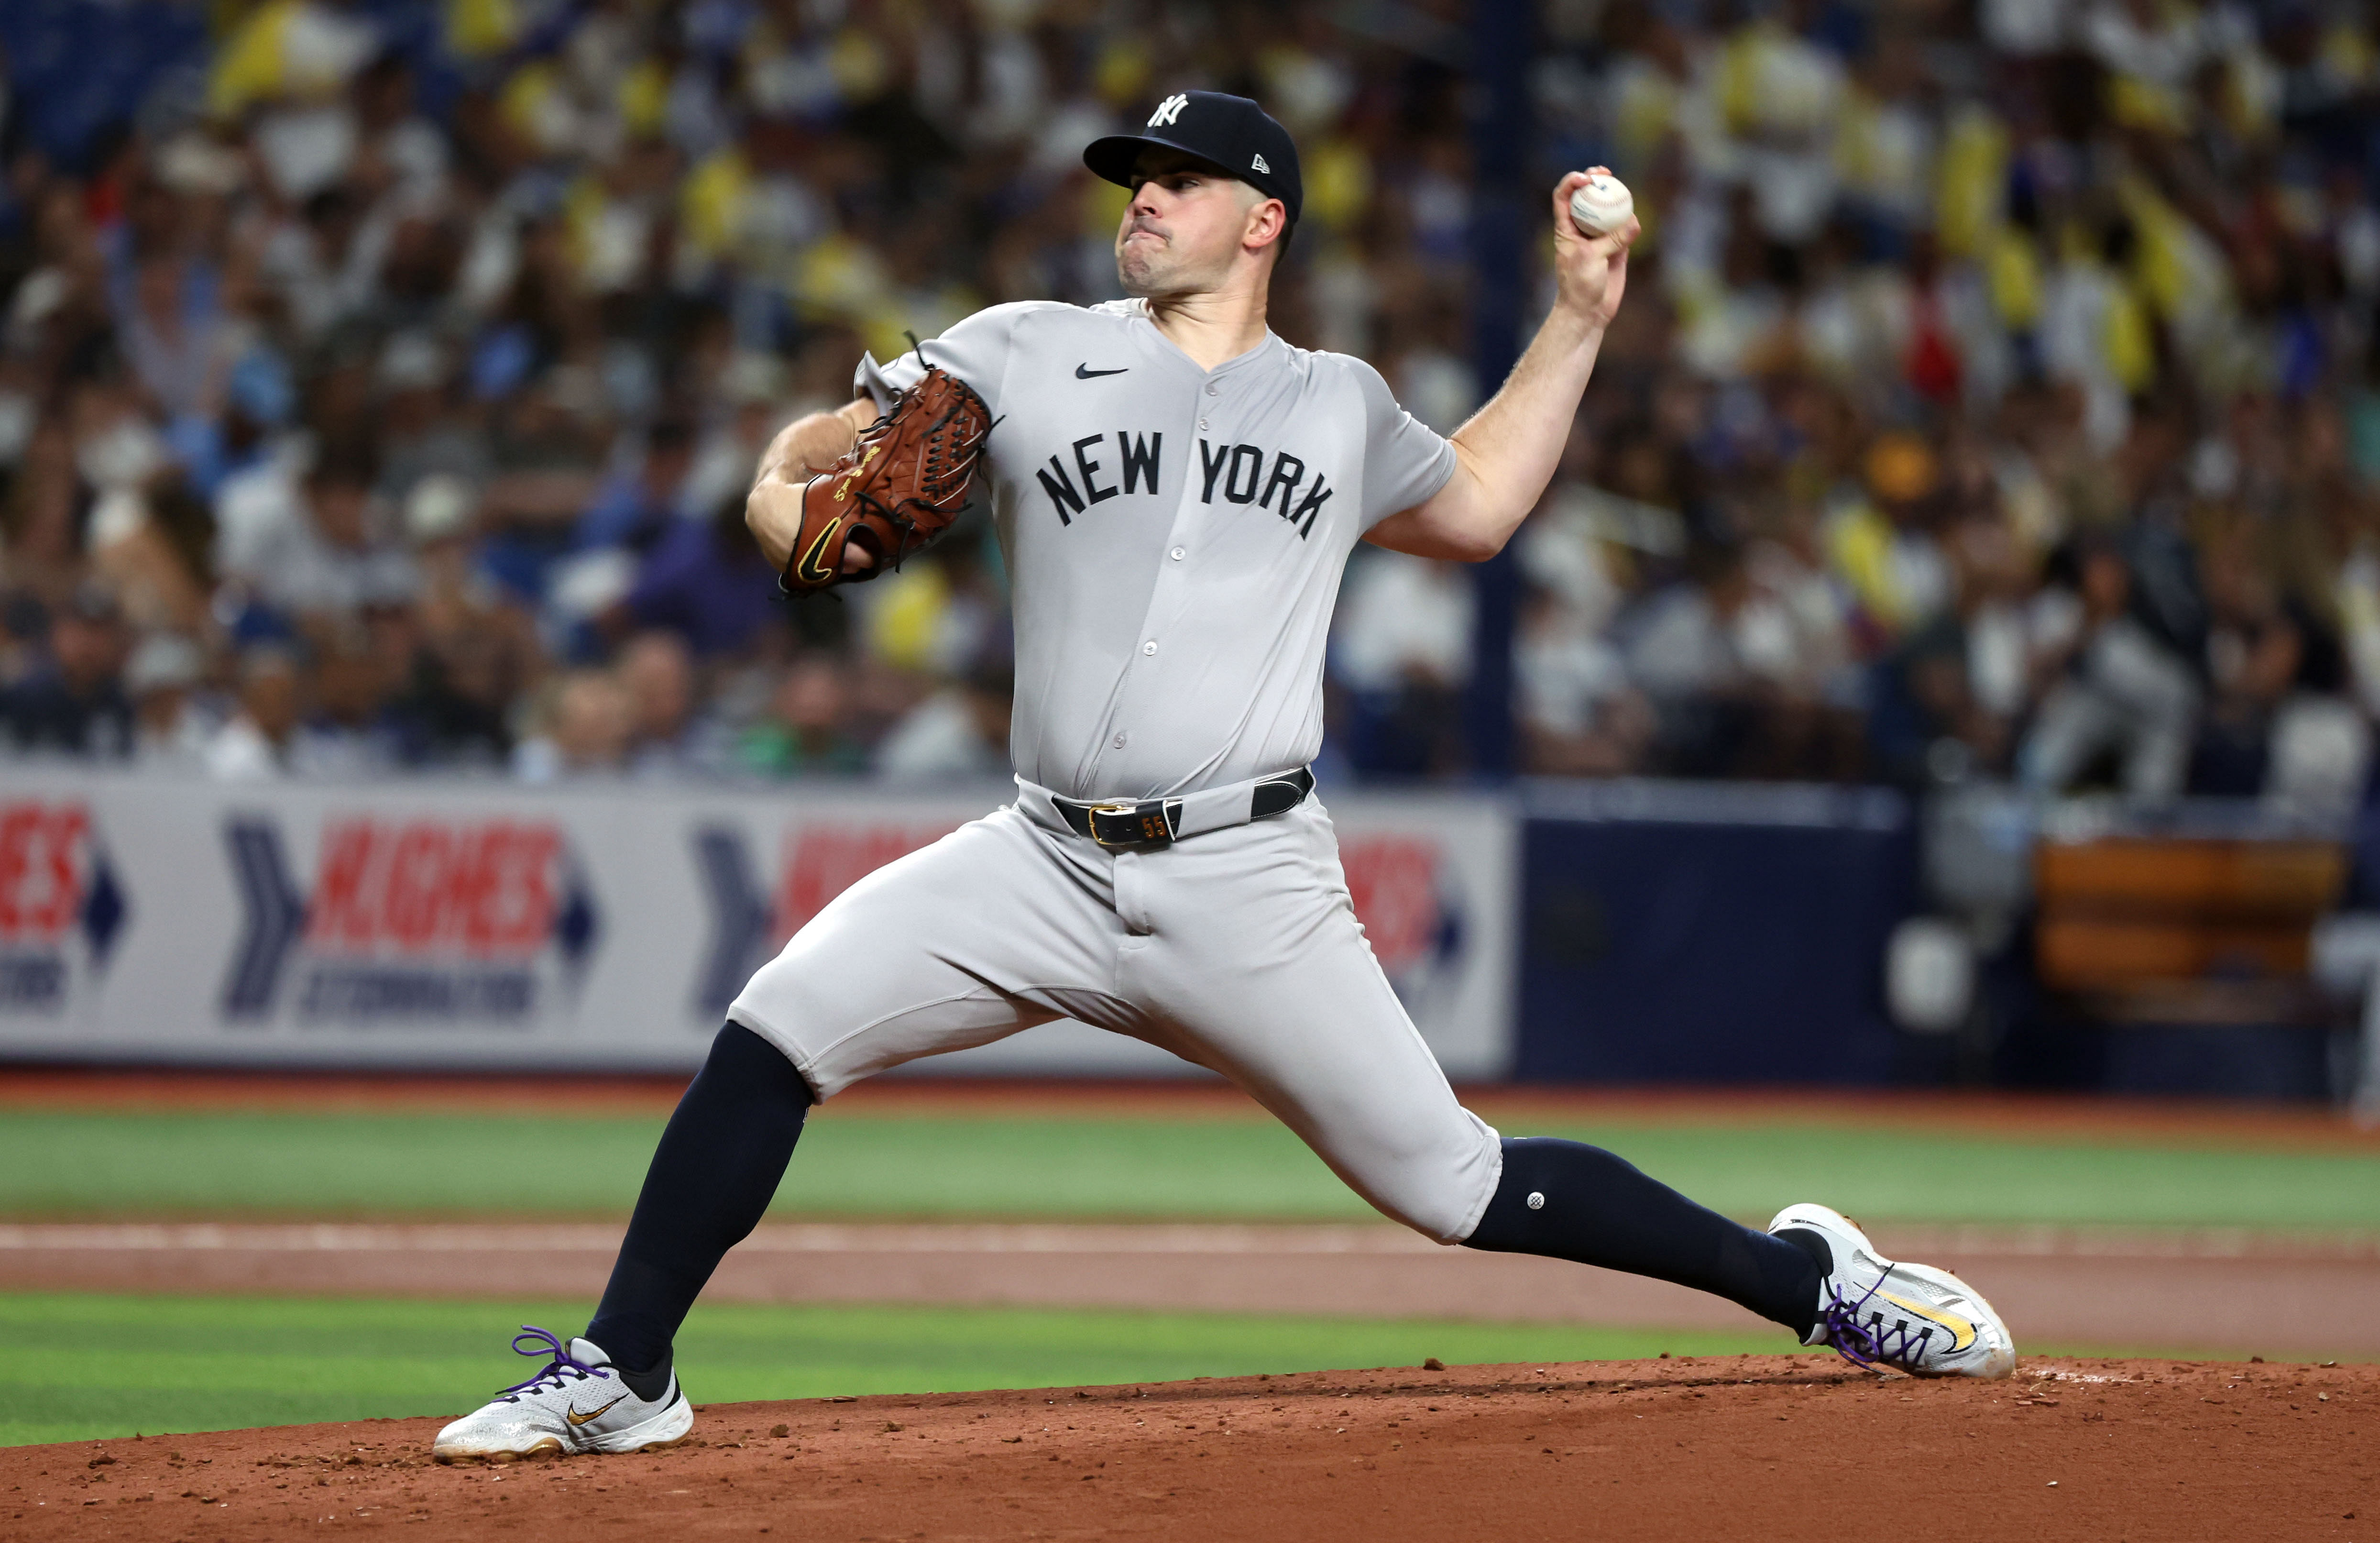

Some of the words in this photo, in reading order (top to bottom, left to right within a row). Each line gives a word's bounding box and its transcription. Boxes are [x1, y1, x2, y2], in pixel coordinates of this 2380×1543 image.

[1147, 94, 1189, 127] NY
[1036, 430, 1163, 527] NEW
[1199, 438, 1333, 541] YORK
[1141, 816, 1166, 838] 55
